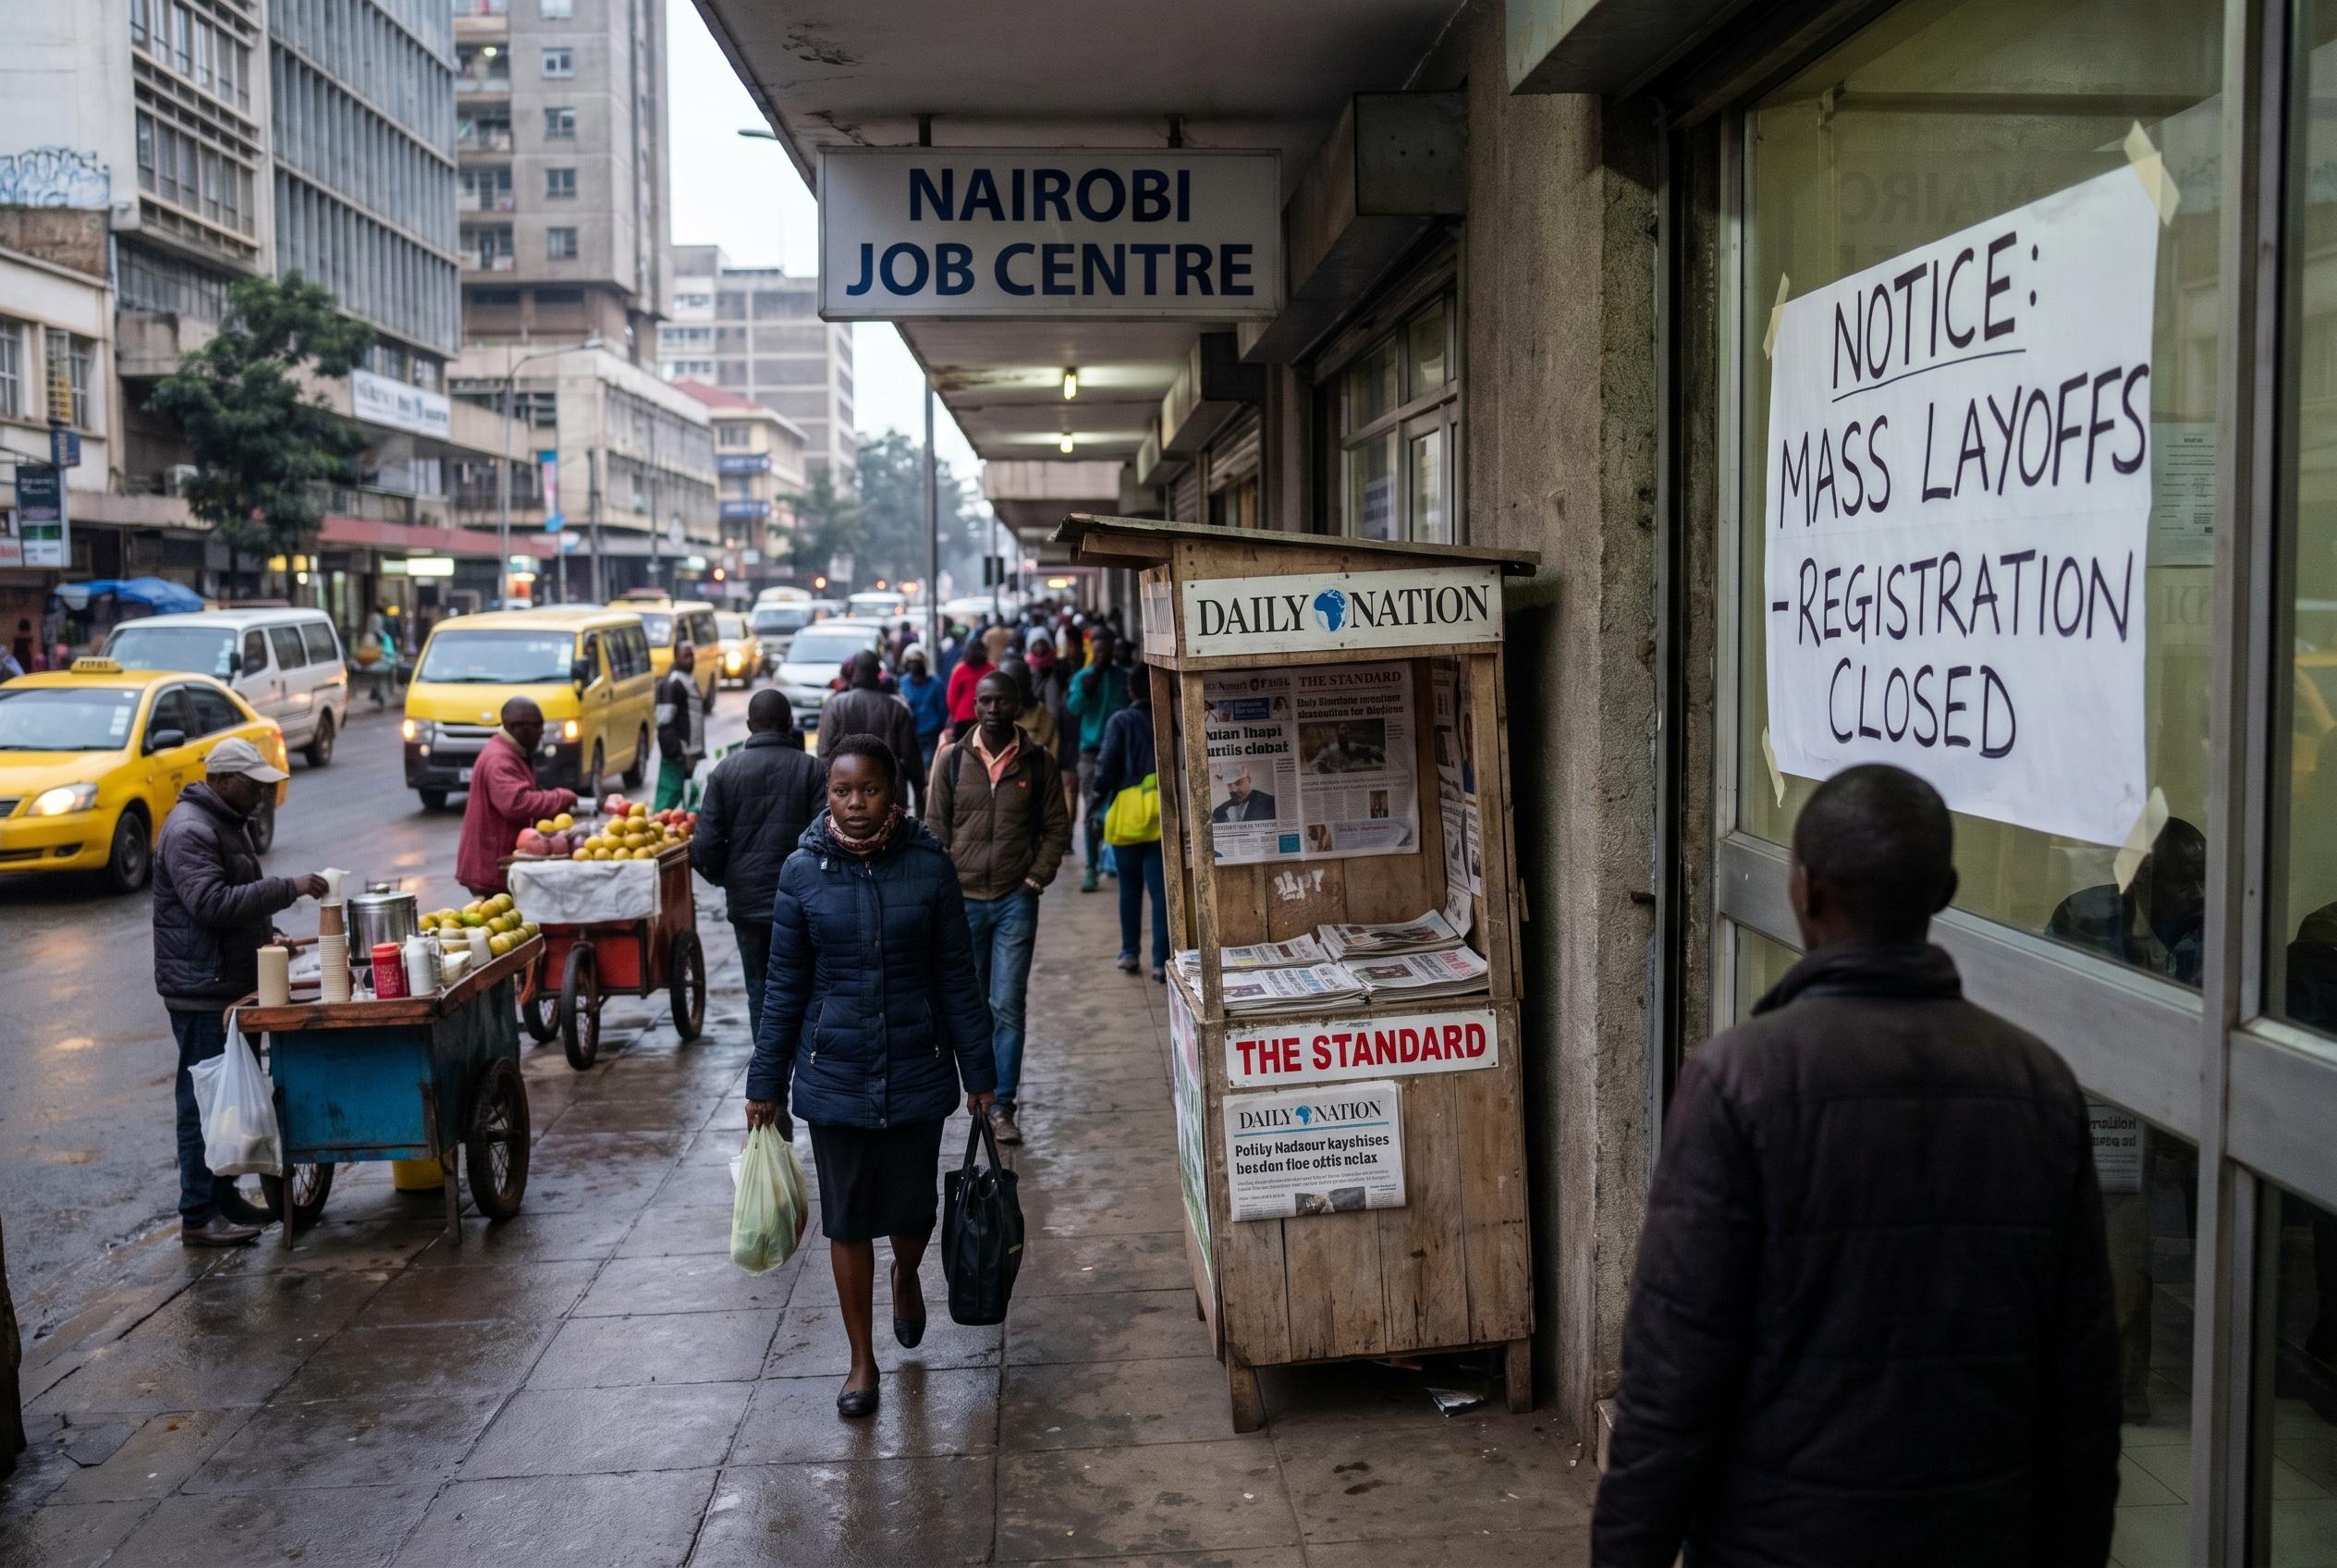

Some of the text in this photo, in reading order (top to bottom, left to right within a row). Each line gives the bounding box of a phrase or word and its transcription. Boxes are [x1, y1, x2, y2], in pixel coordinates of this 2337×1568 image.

[909, 167, 1191, 223] NAIROBI
[845, 242, 1254, 297] JOB CENTRE
[1831, 230, 2039, 390] NOTICE:
[1779, 414, 1890, 530] MASS
[1921, 362, 2151, 499] LAYOFFS
[1197, 584, 1490, 636] DAILY NATION
[1298, 676, 1327, 688] THE
[1329, 671, 1401, 686] STANDARD
[1827, 655, 2017, 760] CLOSED
[1236, 1023, 1487, 1076] THE STANDARD
[1239, 1100, 1381, 1129] DAILY NATION
